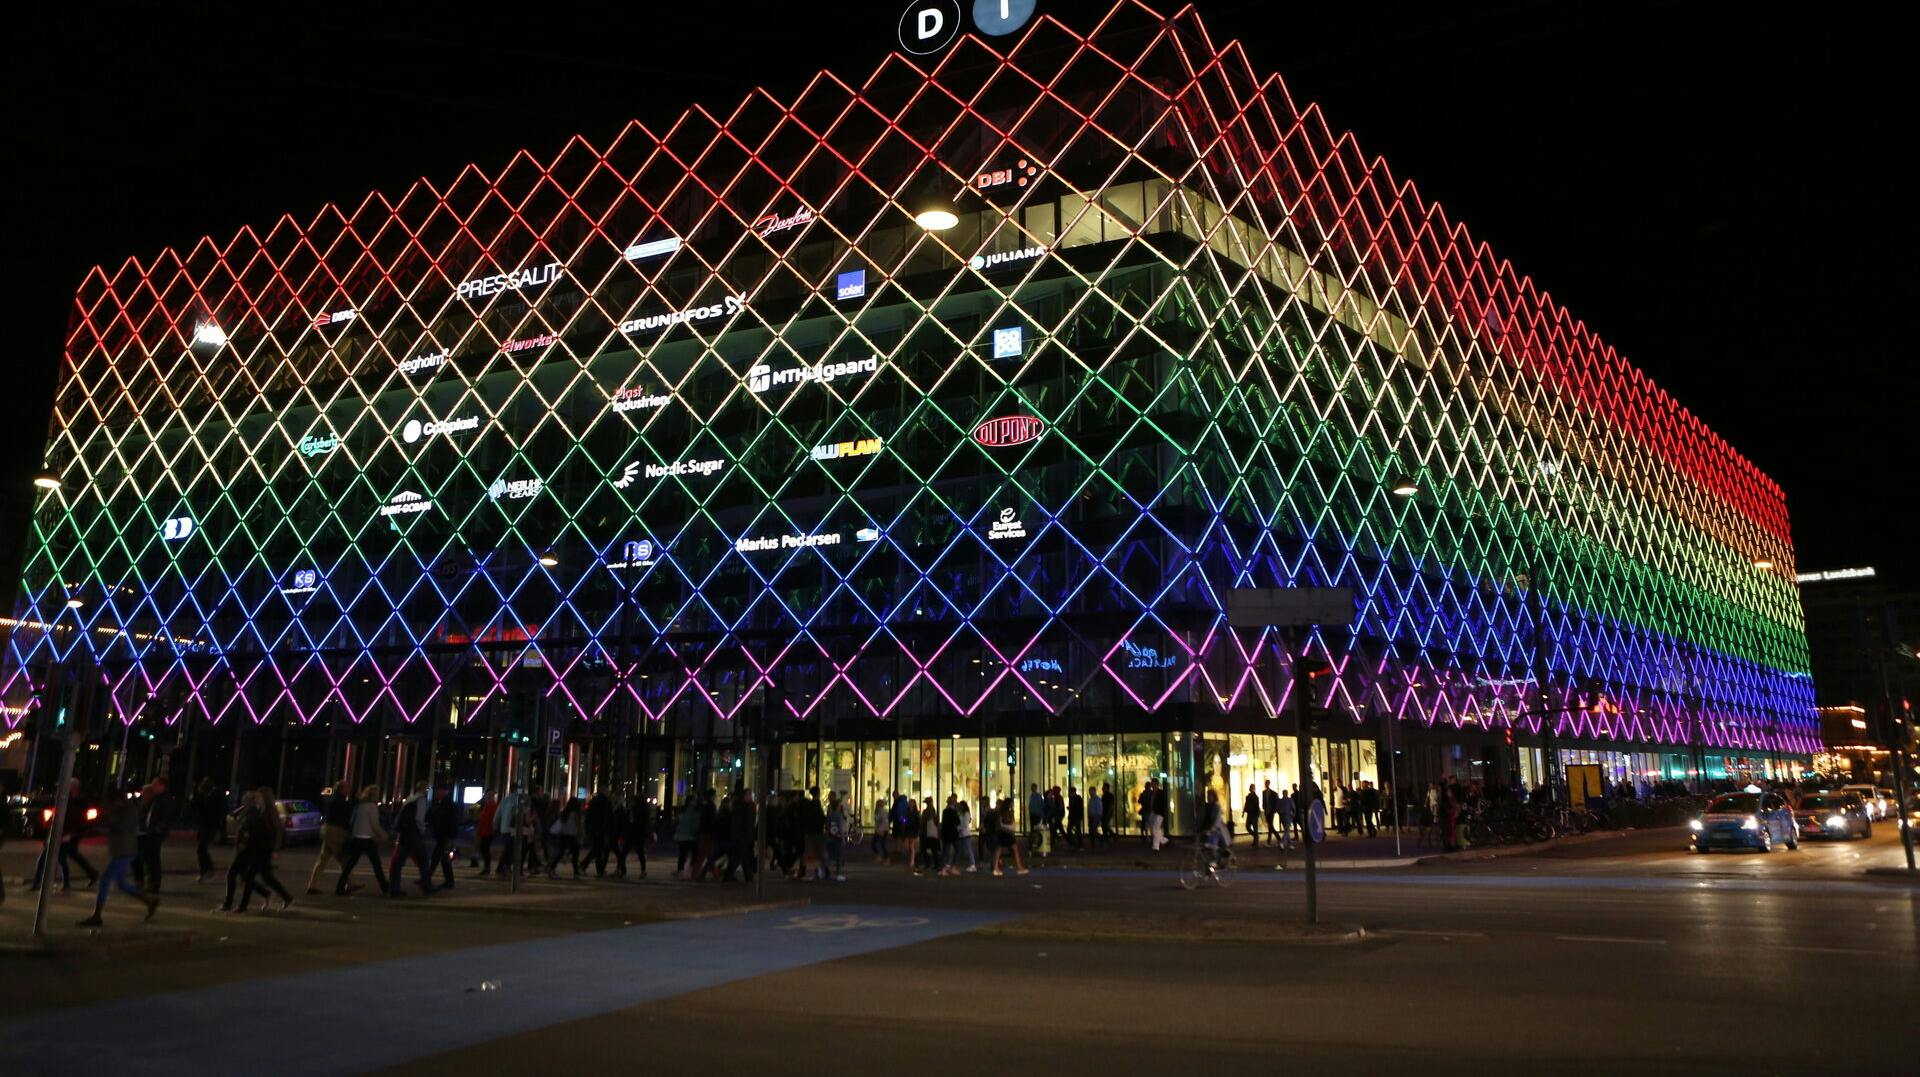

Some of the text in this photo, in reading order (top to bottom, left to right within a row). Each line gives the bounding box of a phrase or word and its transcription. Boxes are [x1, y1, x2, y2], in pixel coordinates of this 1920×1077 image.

[977, 168, 1012, 189] DBI
[756, 205, 813, 238] Danfoss
[985, 246, 1046, 269] JULIANA
[456, 262, 561, 301] PRESSALIT
[838, 284, 864, 297] solar
[619, 303, 723, 333] GRUNDFOS
[423, 416, 479, 435] Coloplast
[1000, 418, 1039, 444] PONT
[300, 432, 339, 458] Carlsberg
[809, 437, 882, 460] ALUFLAM
[645, 459, 725, 478] Nordic Sugar
[988, 529, 1027, 540] Services
[992, 520, 1022, 532] Eurest
[735, 537, 779, 551] Marius
[551, 729, 561, 744] P
